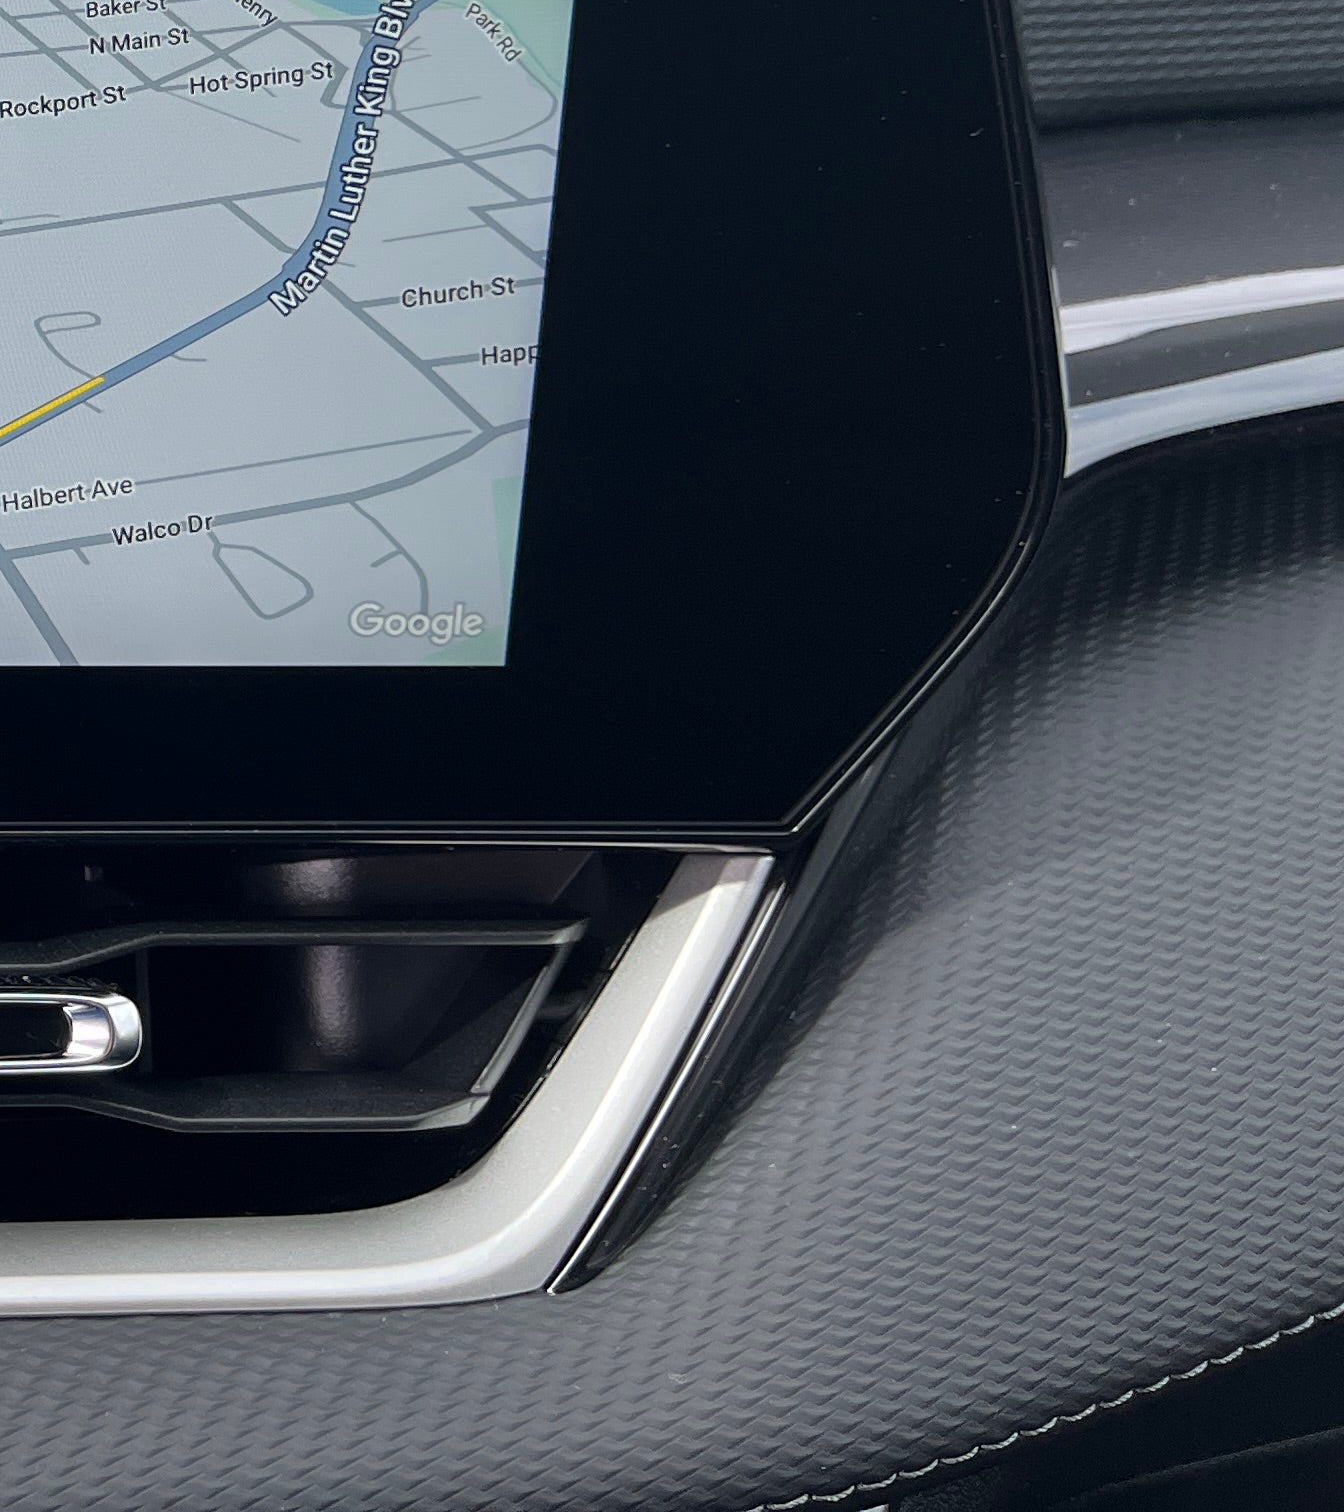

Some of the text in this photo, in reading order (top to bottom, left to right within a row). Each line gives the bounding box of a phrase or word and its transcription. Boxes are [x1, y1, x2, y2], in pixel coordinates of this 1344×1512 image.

[86, 0, 140, 18] Baker
[89, 28, 189, 54] N Main St
[465, 3, 522, 63] Park Rd
[190, 62, 333, 95] Hot Spring St
[353, 46, 402, 117] King
[0, 85, 127, 119] Rockport St
[328, 122, 379, 223] Luther
[268, 226, 350, 317] Martin
[402, 277, 515, 308] Church St
[3, 477, 133, 512] Halbert Ave
[112, 515, 213, 545] Walco Dr
[349, 602, 484, 644] Google
